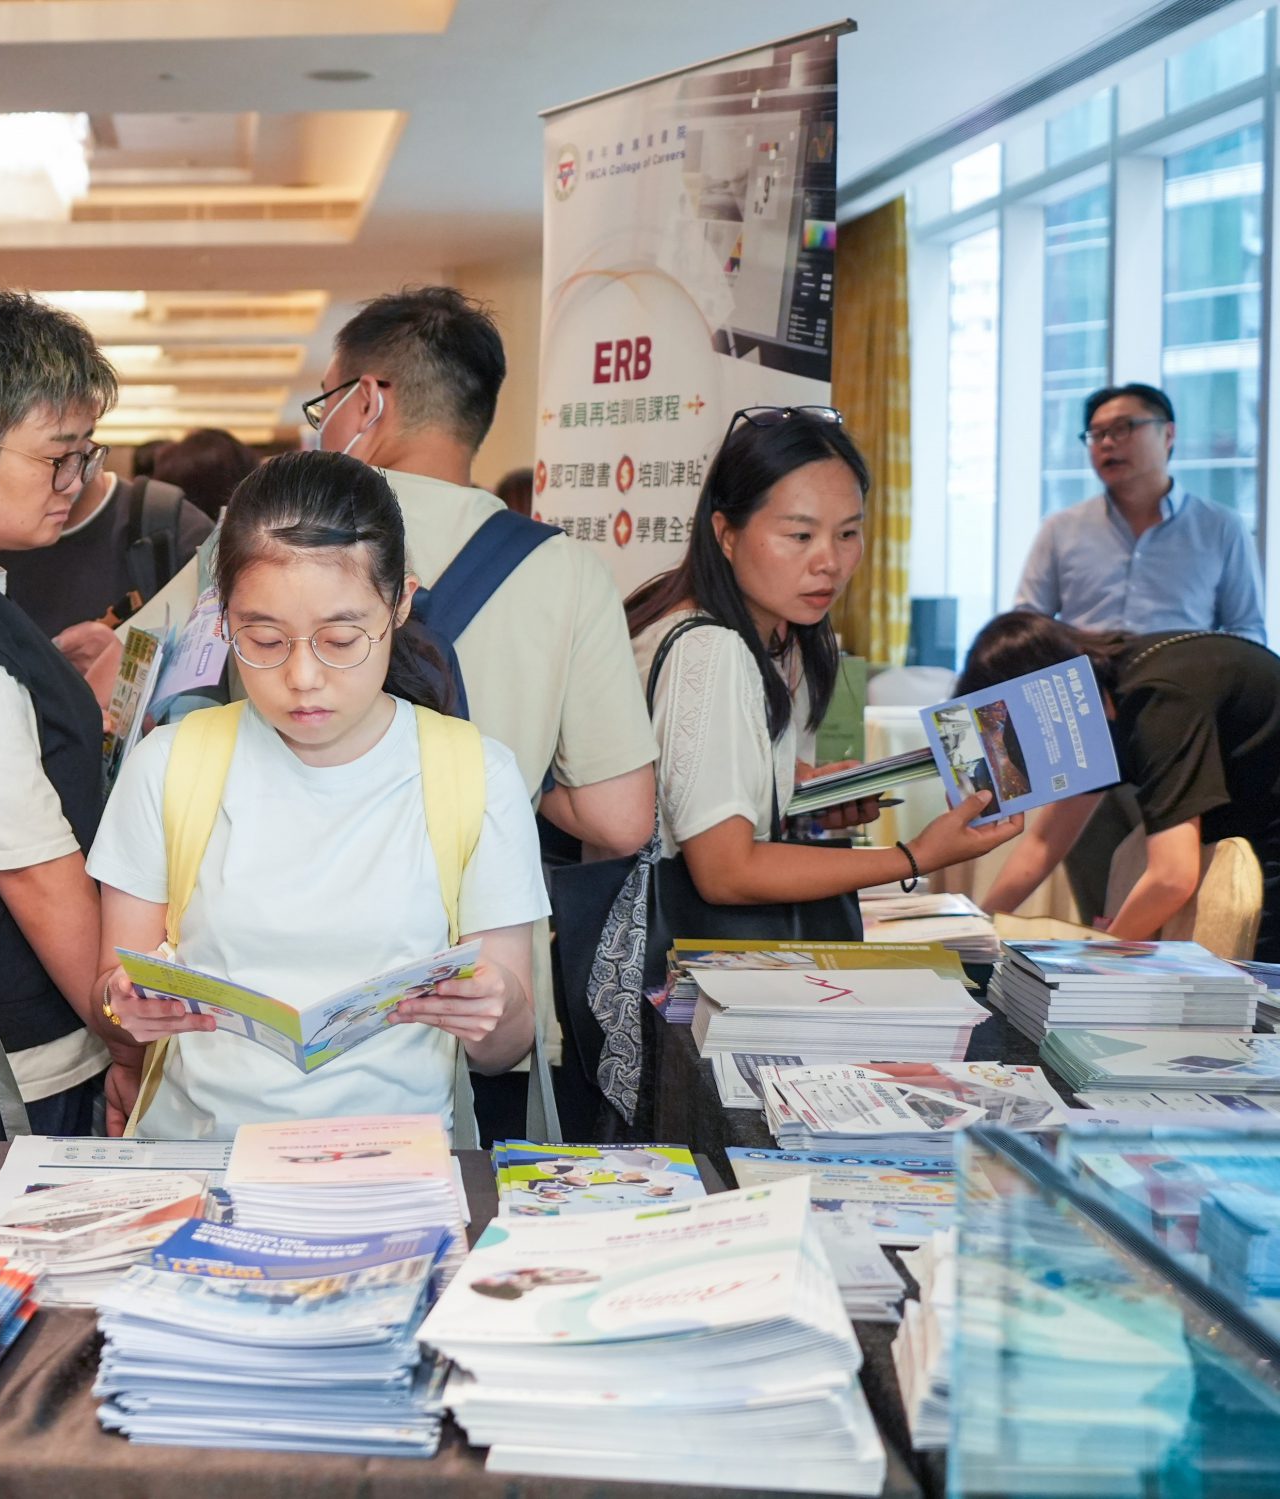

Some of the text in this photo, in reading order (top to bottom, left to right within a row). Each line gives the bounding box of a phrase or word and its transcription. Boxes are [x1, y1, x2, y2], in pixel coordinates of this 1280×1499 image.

[593, 336, 652, 384] ERB
[559, 394, 680, 429] 僱員再培訓局課程
[549, 461, 612, 489] 認可證書
